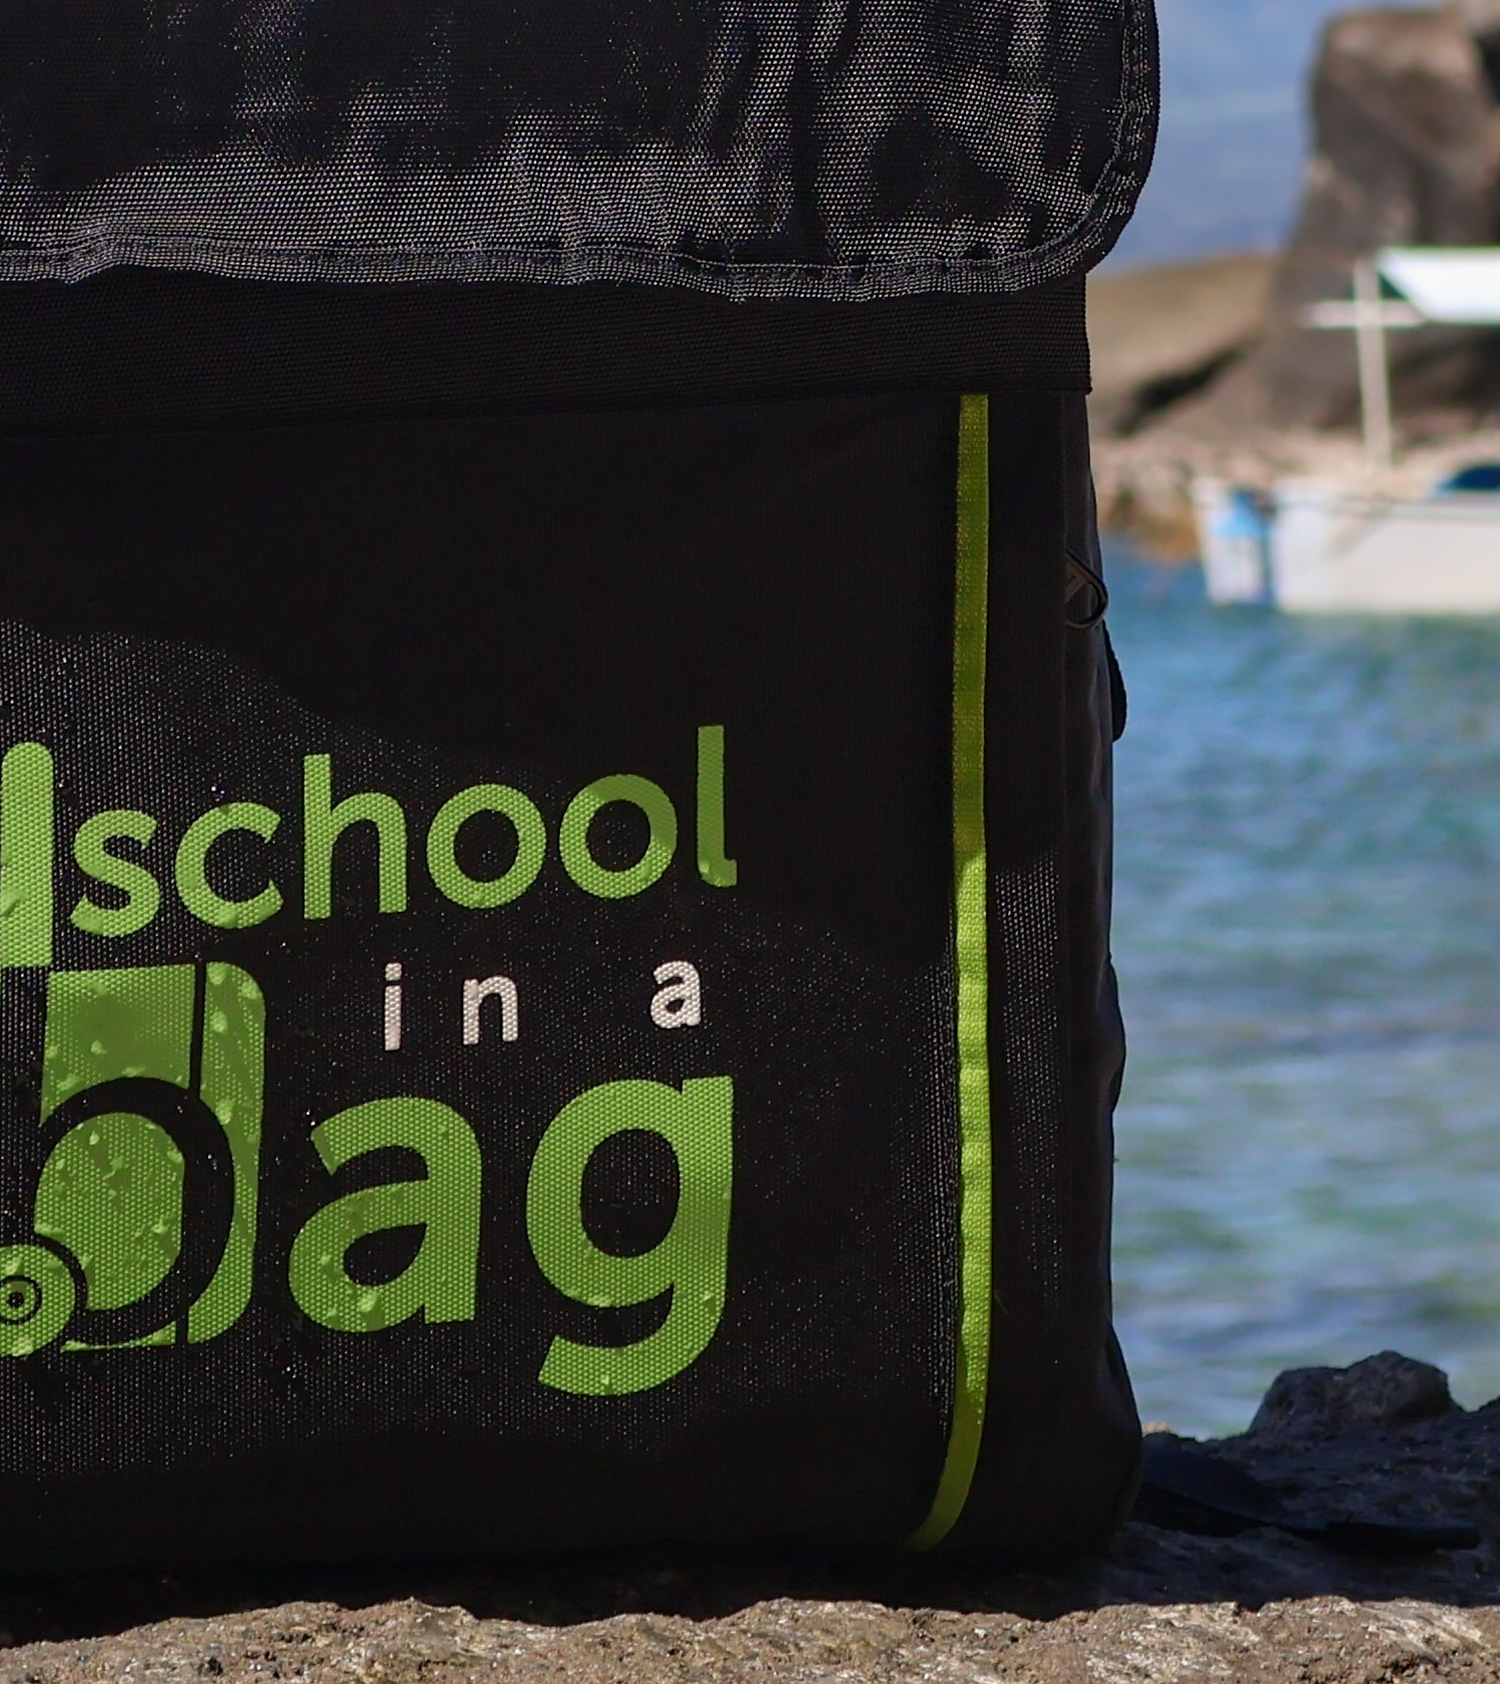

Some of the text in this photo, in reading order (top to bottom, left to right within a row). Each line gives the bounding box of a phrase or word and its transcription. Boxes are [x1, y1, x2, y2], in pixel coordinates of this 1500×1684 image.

[68, 724, 739, 938] school
[383, 959, 702, 1052] in a
